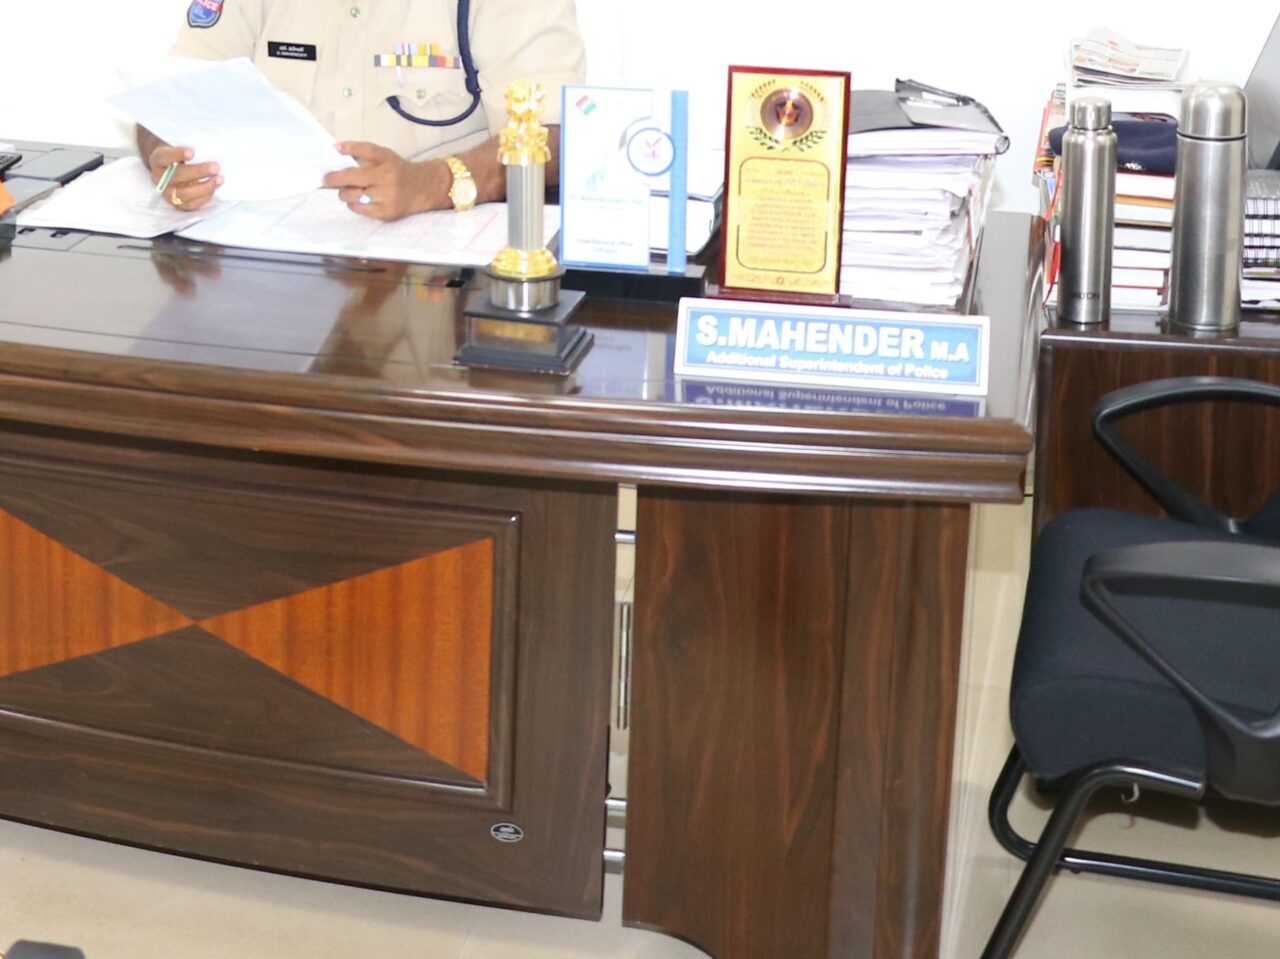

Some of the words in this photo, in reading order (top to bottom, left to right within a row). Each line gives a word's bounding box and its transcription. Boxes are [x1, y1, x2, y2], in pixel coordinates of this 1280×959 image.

[695, 314, 925, 360] S.MAHENDER
[930, 340, 970, 362] M.A
[706, 350, 776, 368] Additional
[780, 355, 885, 375] Superintendent
[887, 363, 903, 377] of
[905, 364, 949, 380] Police
